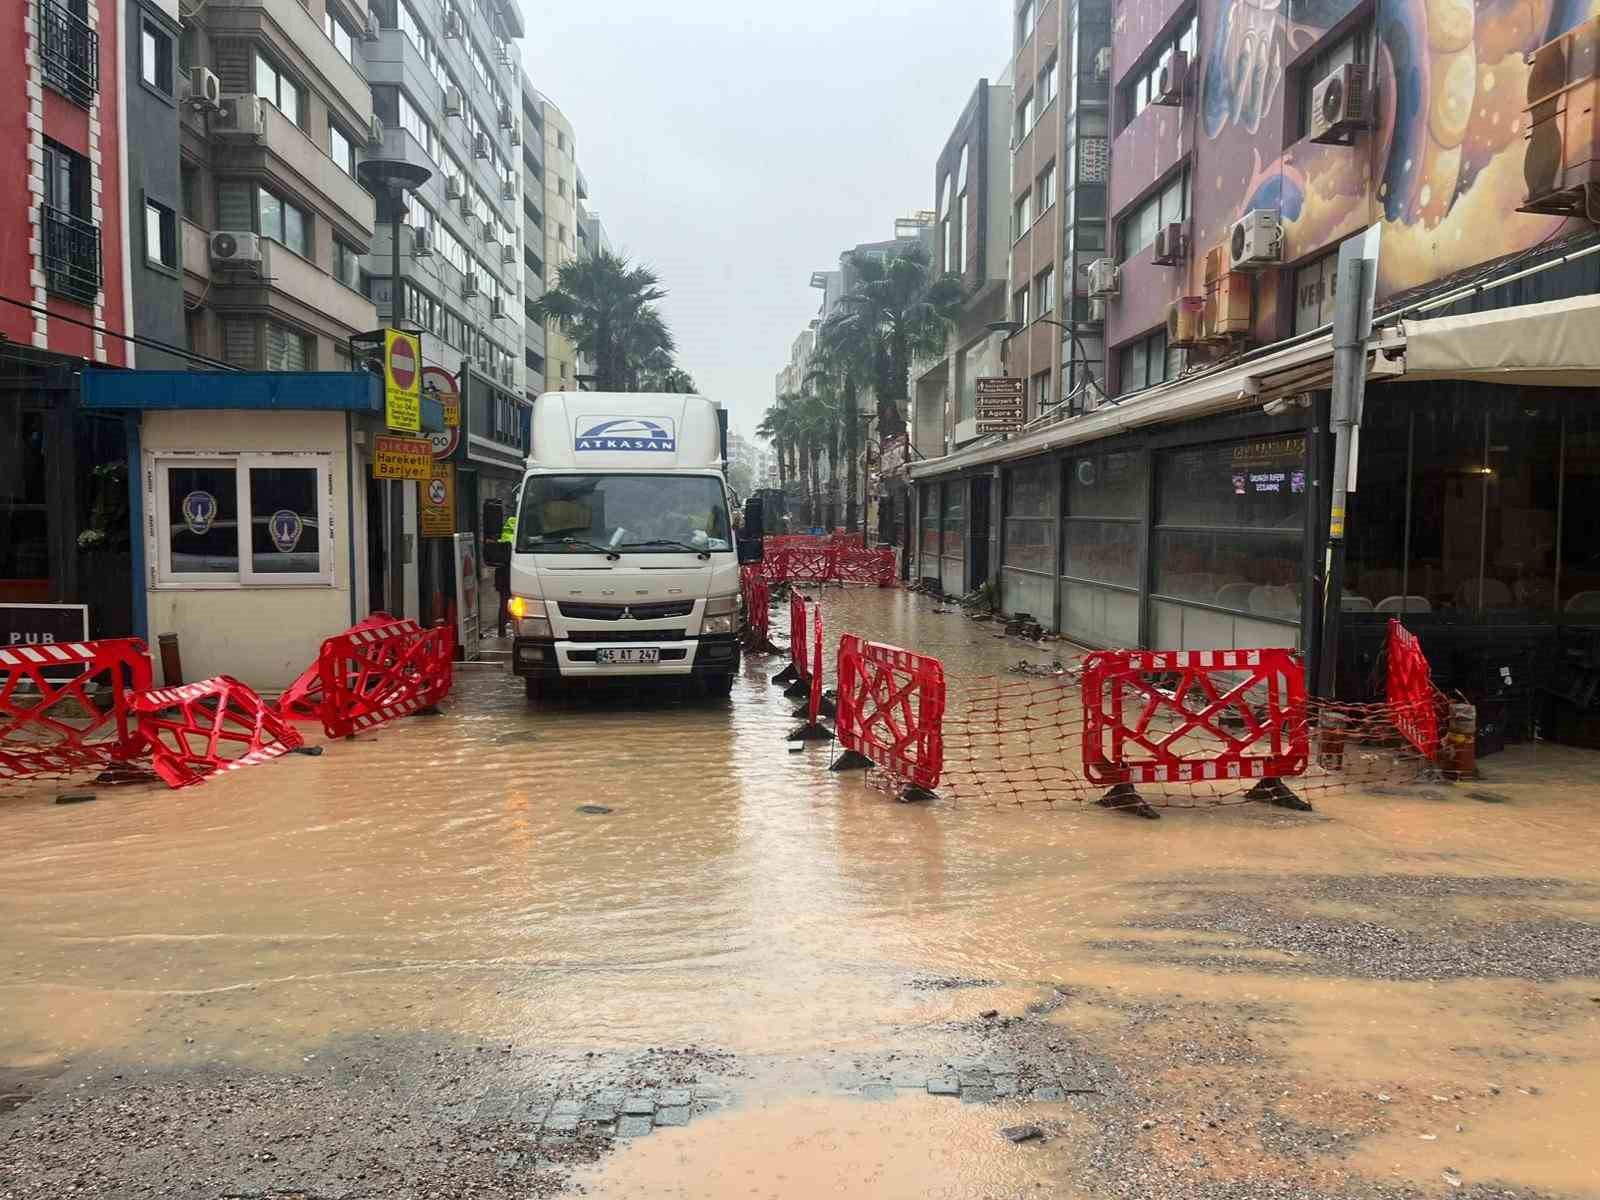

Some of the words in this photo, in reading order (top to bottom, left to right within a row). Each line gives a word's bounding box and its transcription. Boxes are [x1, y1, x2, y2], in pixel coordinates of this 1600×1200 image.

[579, 440, 673, 449] ATKASAN
[377, 453, 430, 465] Hareketli
[381, 463, 426, 475] Bariyer
[10, 632, 55, 644] PUB
[620, 649, 633, 660] AT
[639, 649, 657, 660] 247
